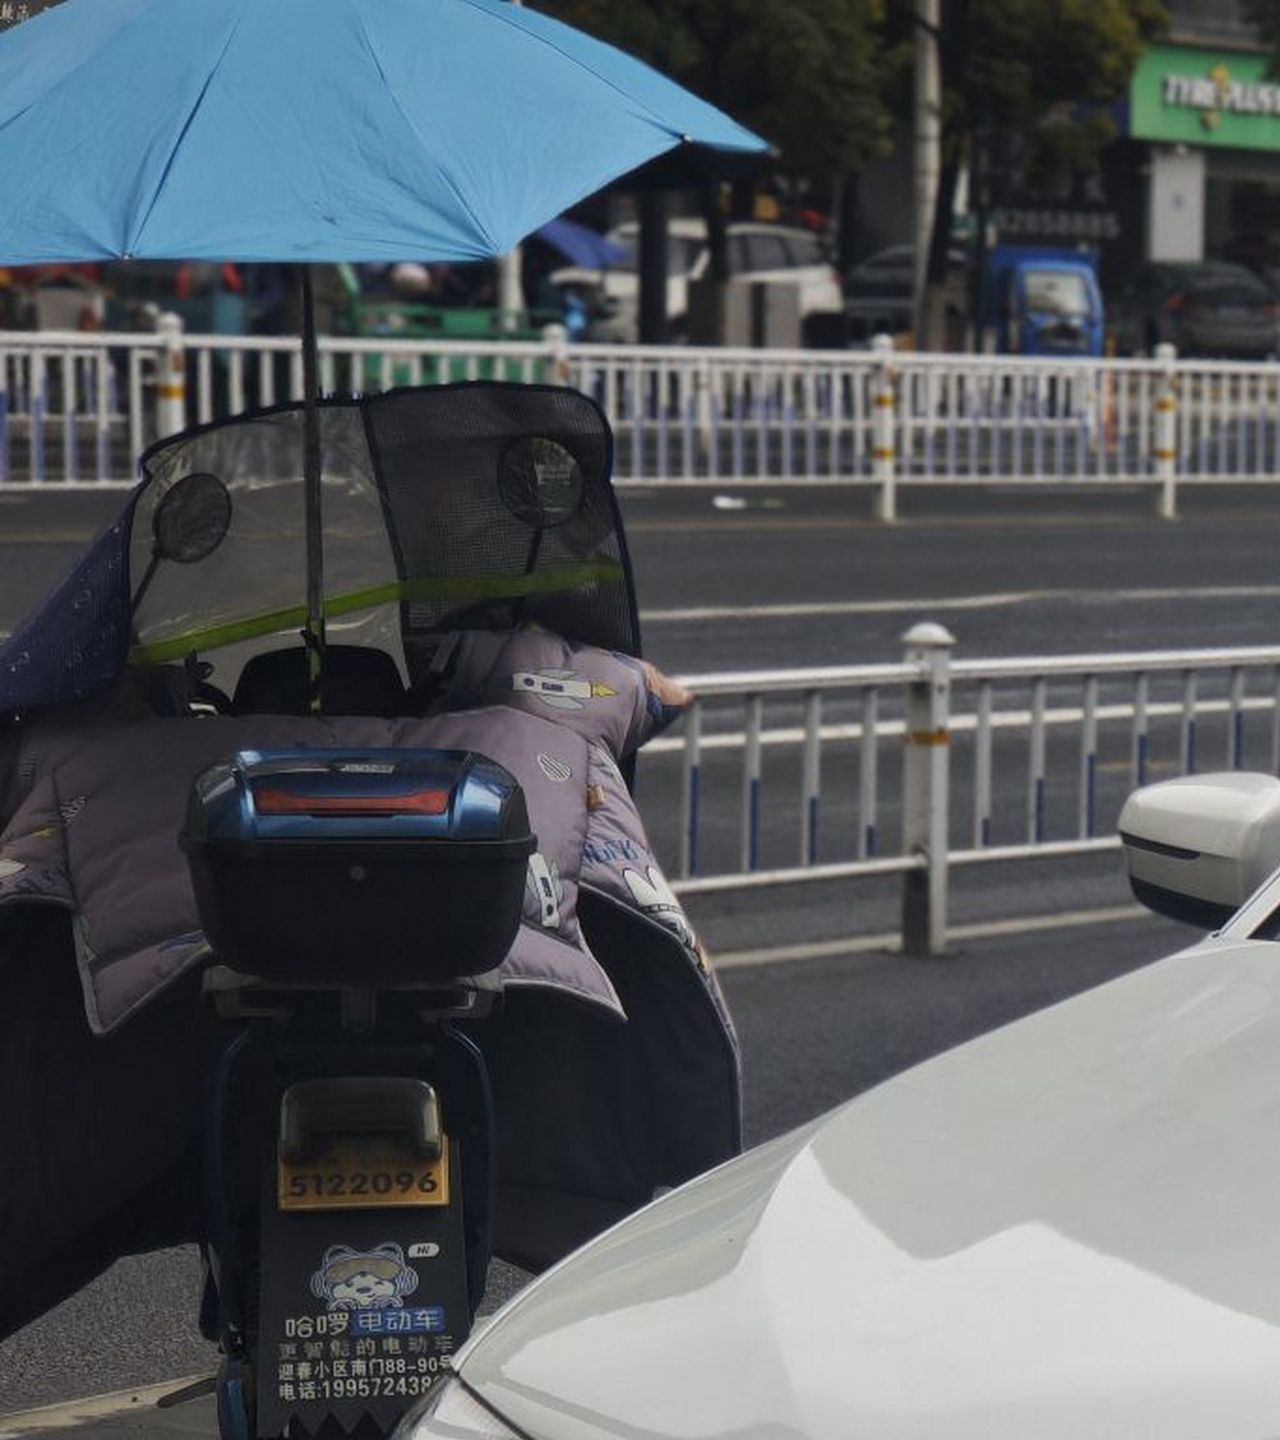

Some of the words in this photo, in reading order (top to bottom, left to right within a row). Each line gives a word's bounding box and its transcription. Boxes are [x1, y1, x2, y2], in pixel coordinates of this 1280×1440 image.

[288, 1171, 438, 1198] 5122096
[358, 1308, 439, 1333] 电动车
[278, 1375, 441, 1402] 电话:199572438
